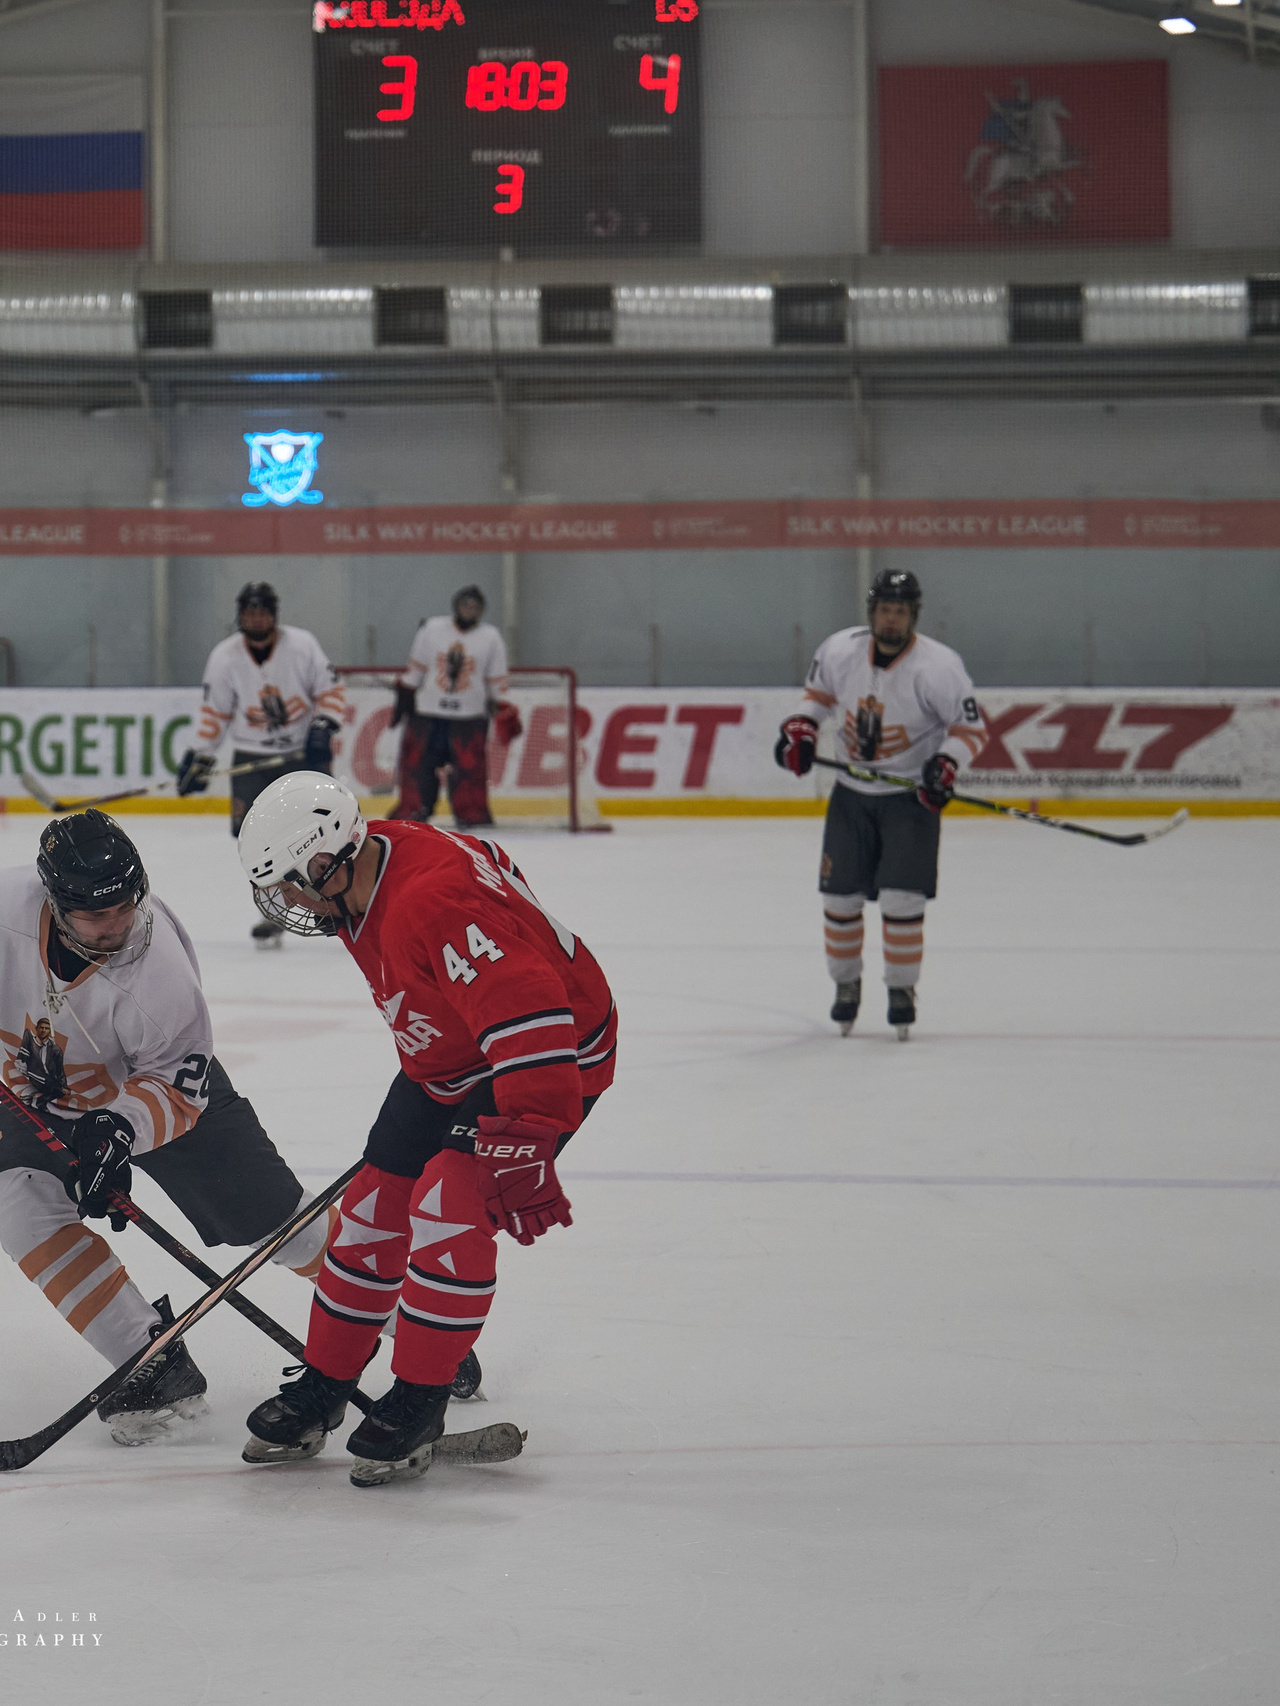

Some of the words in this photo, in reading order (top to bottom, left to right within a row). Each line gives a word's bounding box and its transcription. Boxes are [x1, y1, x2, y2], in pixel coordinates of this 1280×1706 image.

[376, 55, 418, 121] 3
[639, 54, 681, 114] 4
[493, 163, 525, 214] 3
[0, 523, 85, 543] LEAGUE
[324, 523, 371, 542] SILK
[377, 522, 427, 541] WAY
[433, 521, 520, 541] HOCKEY
[529, 520, 618, 540] LEAGUE
[788, 517, 836, 536] SILK
[841, 517, 894, 536] WAY
[899, 516, 993, 535] HOCKEY
[998, 515, 1086, 535] LEAGUE
[968, 704, 1235, 771] X17
[296, 833, 317, 856] CCM
[93, 882, 122, 897] CCM
[441, 922, 506, 986] 44
